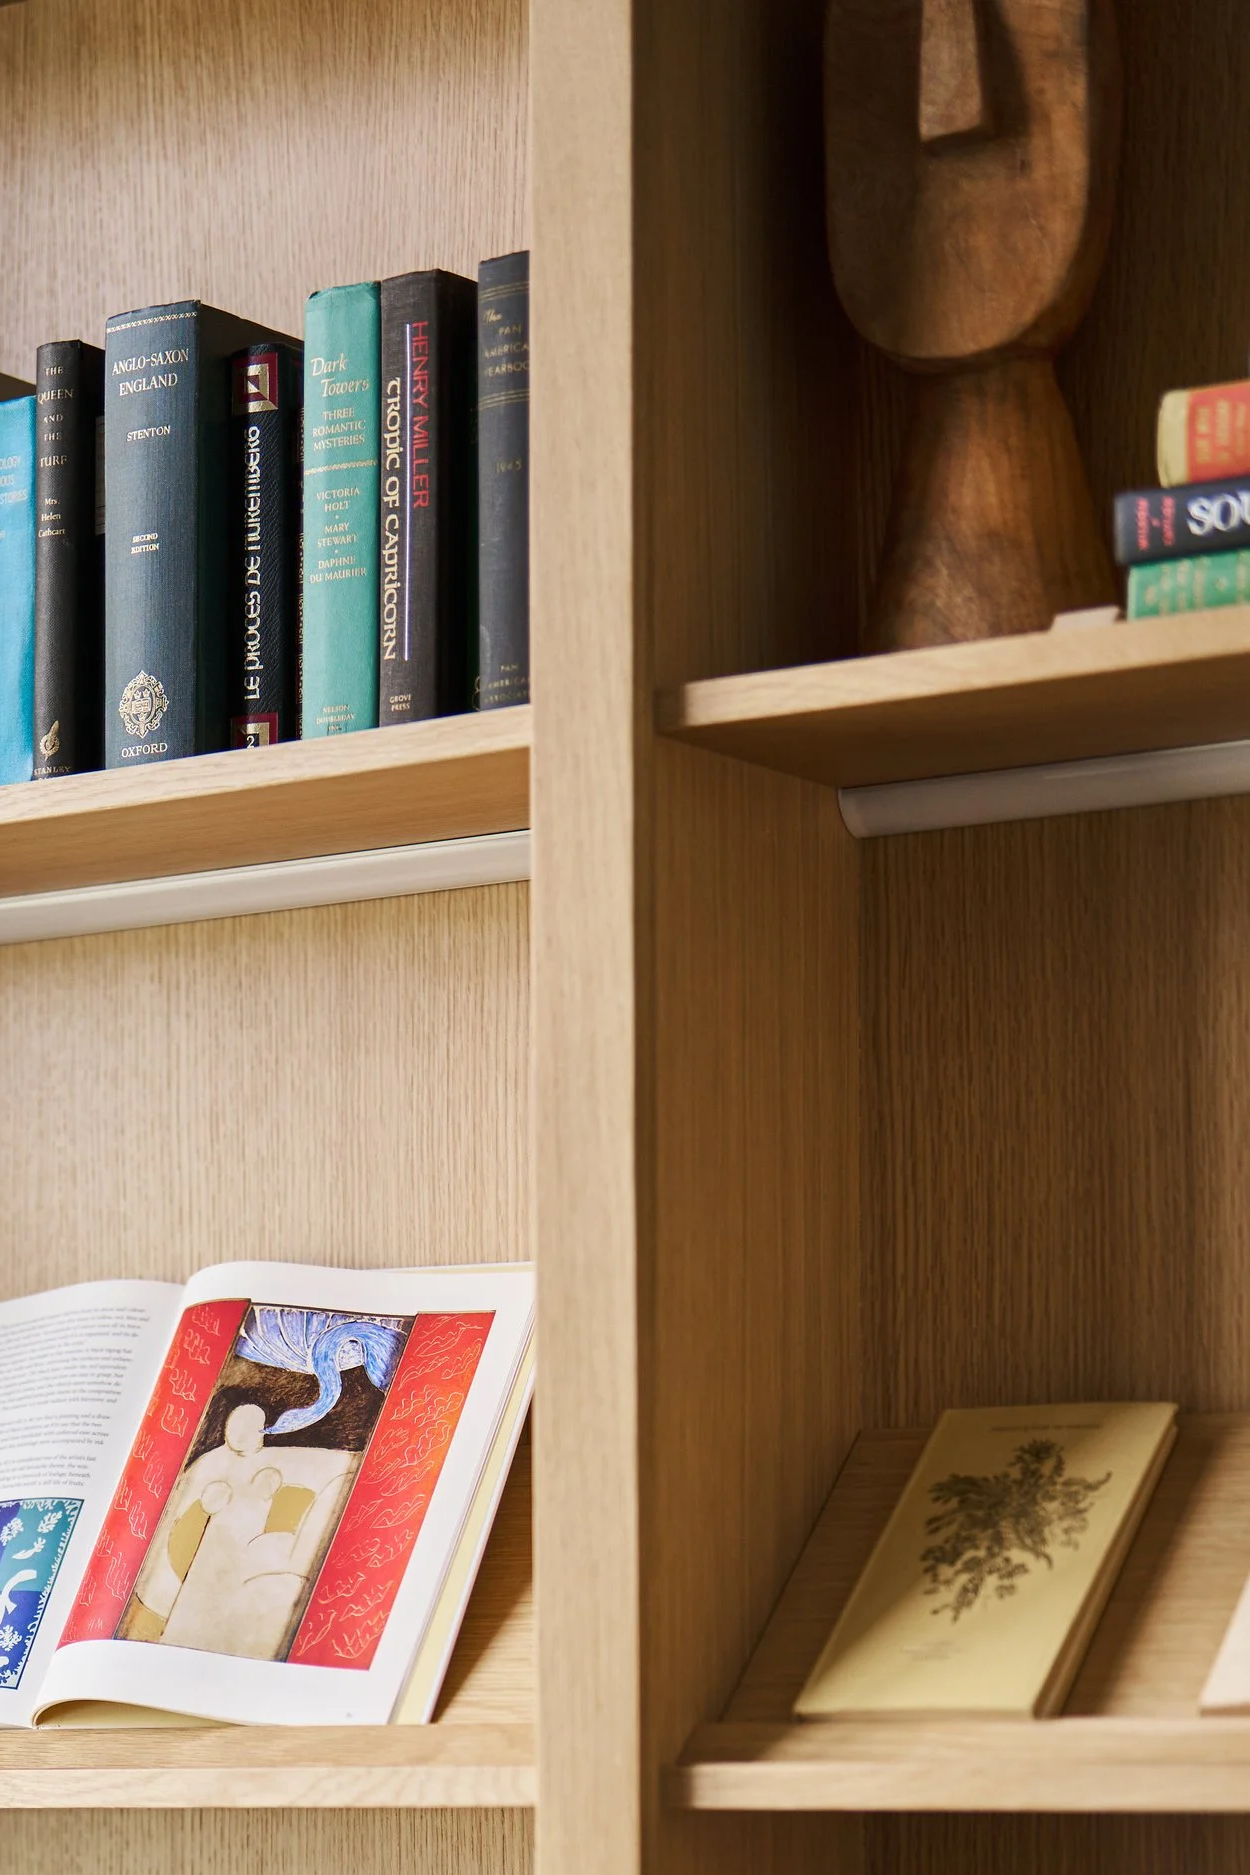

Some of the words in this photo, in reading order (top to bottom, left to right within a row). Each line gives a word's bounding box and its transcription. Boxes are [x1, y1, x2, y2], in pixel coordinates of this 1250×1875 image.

[499, 323, 522, 335] PAN
[112, 348, 190, 377] ANGLO-SAXON
[310, 353, 348, 377] Dark
[412, 321, 430, 407] HENRY
[44, 365, 64, 377] THE
[119, 373, 179, 397] ENGLAND
[320, 377, 370, 398] Towers
[37, 388, 75, 406] QUEEN
[44, 413, 64, 424] AND
[322, 408, 355, 420] THREE
[127, 425, 171, 442] STENTON
[312, 420, 366, 438] ROMANTIC
[44, 431, 63, 442] THE
[313, 433, 365, 452] MYSTERIES
[40, 455, 68, 468] TURF
[412, 416, 430, 509] MILLER
[0, 489, 29, 505] STORIES
[316, 487, 360, 501] VICTORIA
[383, 476, 400, 509] OF
[44, 497, 60, 506] Mrs.
[324, 499, 351, 512] HOLT
[41, 512, 62, 522] Helen
[38, 527, 67, 539] Cathcart
[324, 522, 350, 533] MARY
[132, 532, 159, 544] SECOND
[317, 534, 358, 548] STEWART
[131, 542, 160, 555] EDITION
[317, 556, 356, 568] DAPHNE
[309, 572, 324, 584] DU
[324, 566, 367, 582] MAURIER
[390, 694, 412, 704] GROVE
[322, 704, 350, 715] NELSON
[391, 702, 410, 712] PRESS
[246, 735, 256, 749] 2
[121, 741, 169, 759] OXFORD
[34, 765, 72, 776] STANLEY
